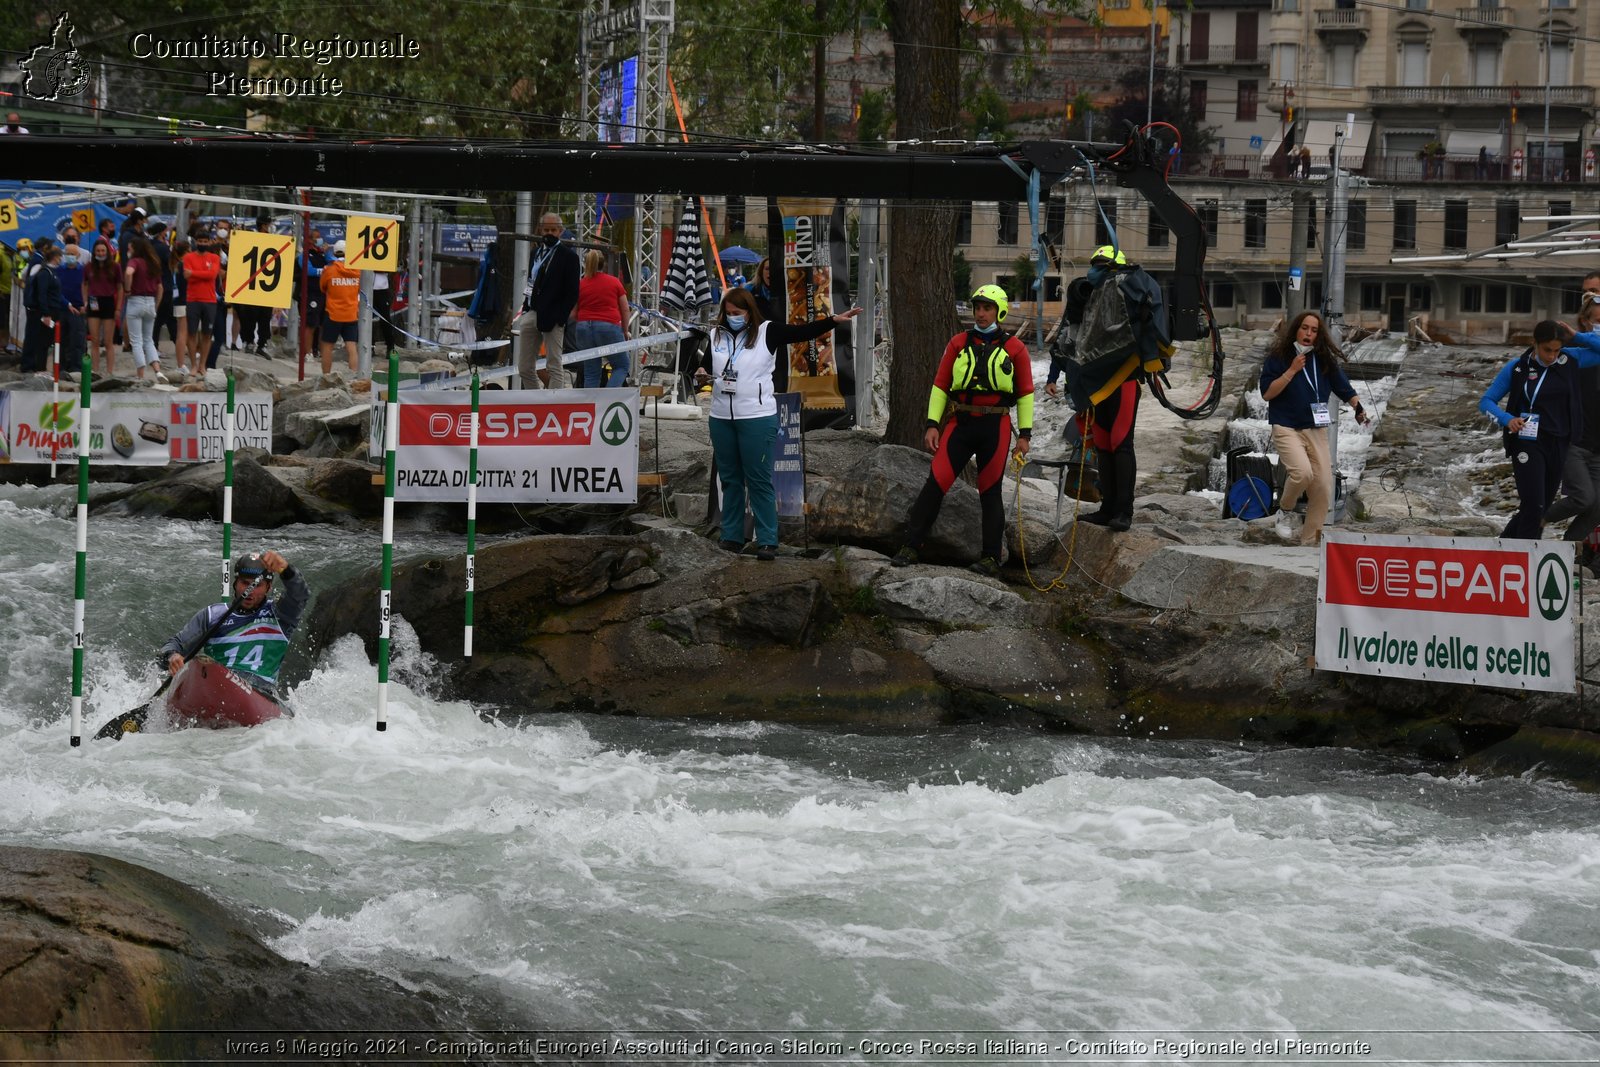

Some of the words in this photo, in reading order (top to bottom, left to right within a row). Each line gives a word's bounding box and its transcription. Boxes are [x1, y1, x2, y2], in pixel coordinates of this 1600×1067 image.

[358, 225, 389, 261] 18
[796, 215, 813, 267] KIND
[243, 246, 282, 292] 19
[331, 277, 360, 287] FRANCE
[429, 411, 593, 438] DESPAR
[397, 469, 448, 487] PIAZZA
[452, 469, 468, 488] DI
[522, 470, 538, 488] 21
[551, 467, 623, 493] IVREA
[1356, 557, 1526, 604] DESPAR
[224, 645, 264, 671] 14
[1354, 631, 1418, 666] valore
[1424, 635, 1478, 671] della
[1486, 641, 1550, 677] scelta
